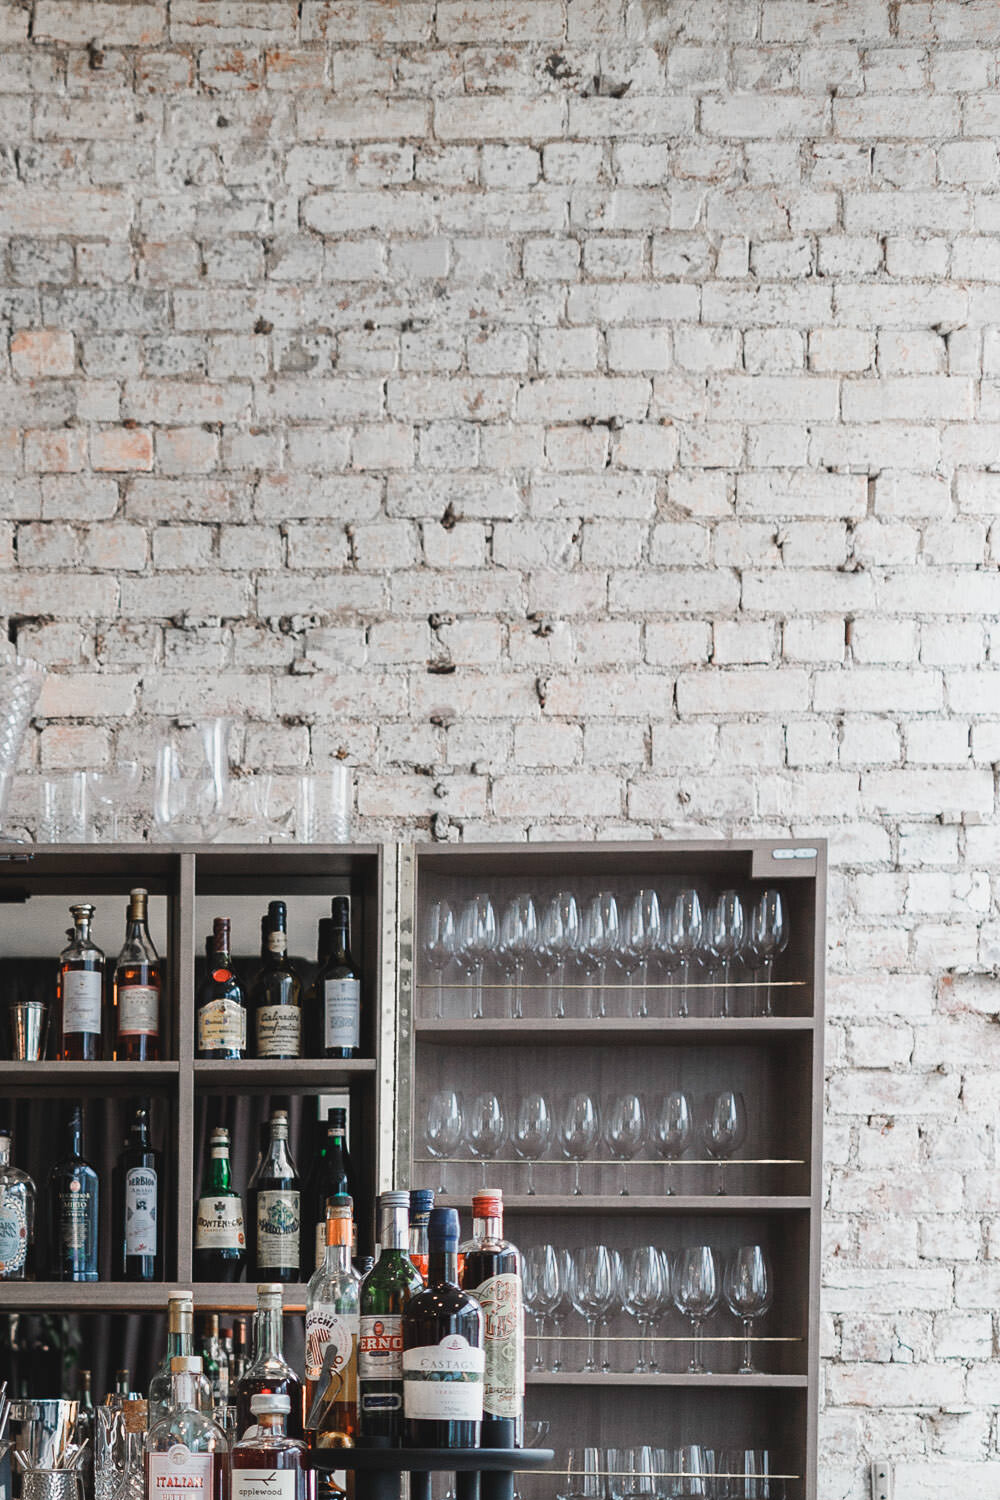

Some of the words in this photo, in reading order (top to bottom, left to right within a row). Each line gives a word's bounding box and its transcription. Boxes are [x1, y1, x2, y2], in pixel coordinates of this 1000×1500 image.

[360, 1337, 402, 1349] ERNO
[420, 1358, 477, 1369] CASTAGN
[156, 1476, 204, 1488] ITALIAN
[238, 1487, 282, 1497] applewood
